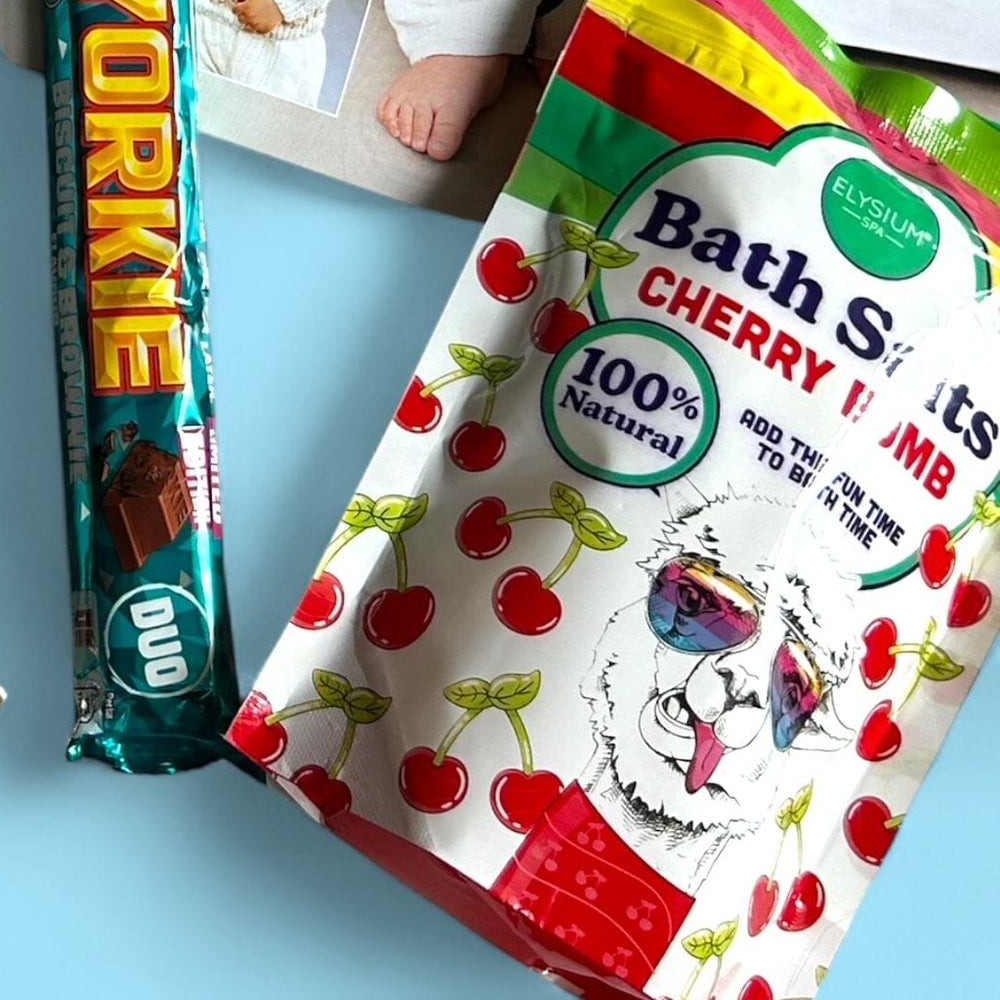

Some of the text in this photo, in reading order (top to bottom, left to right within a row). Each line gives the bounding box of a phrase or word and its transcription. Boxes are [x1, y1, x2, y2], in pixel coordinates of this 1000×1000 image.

[52, 78, 77, 235] BISCUIT
[860, 216, 885, 238] SPA
[633, 188, 999, 460] Bath Sts
[637, 266, 836, 395] CHERRY
[58, 286, 89, 482] BROWNIE
[558, 384, 684, 461] Natural
[572, 347, 700, 422] 100%
[739, 408, 783, 445] ADD
[832, 472, 866, 507] FUN
[866, 498, 905, 546] TIME
[757, 442, 785, 471] TO
[838, 502, 877, 550] TIME
[129, 596, 189, 688] DUO
